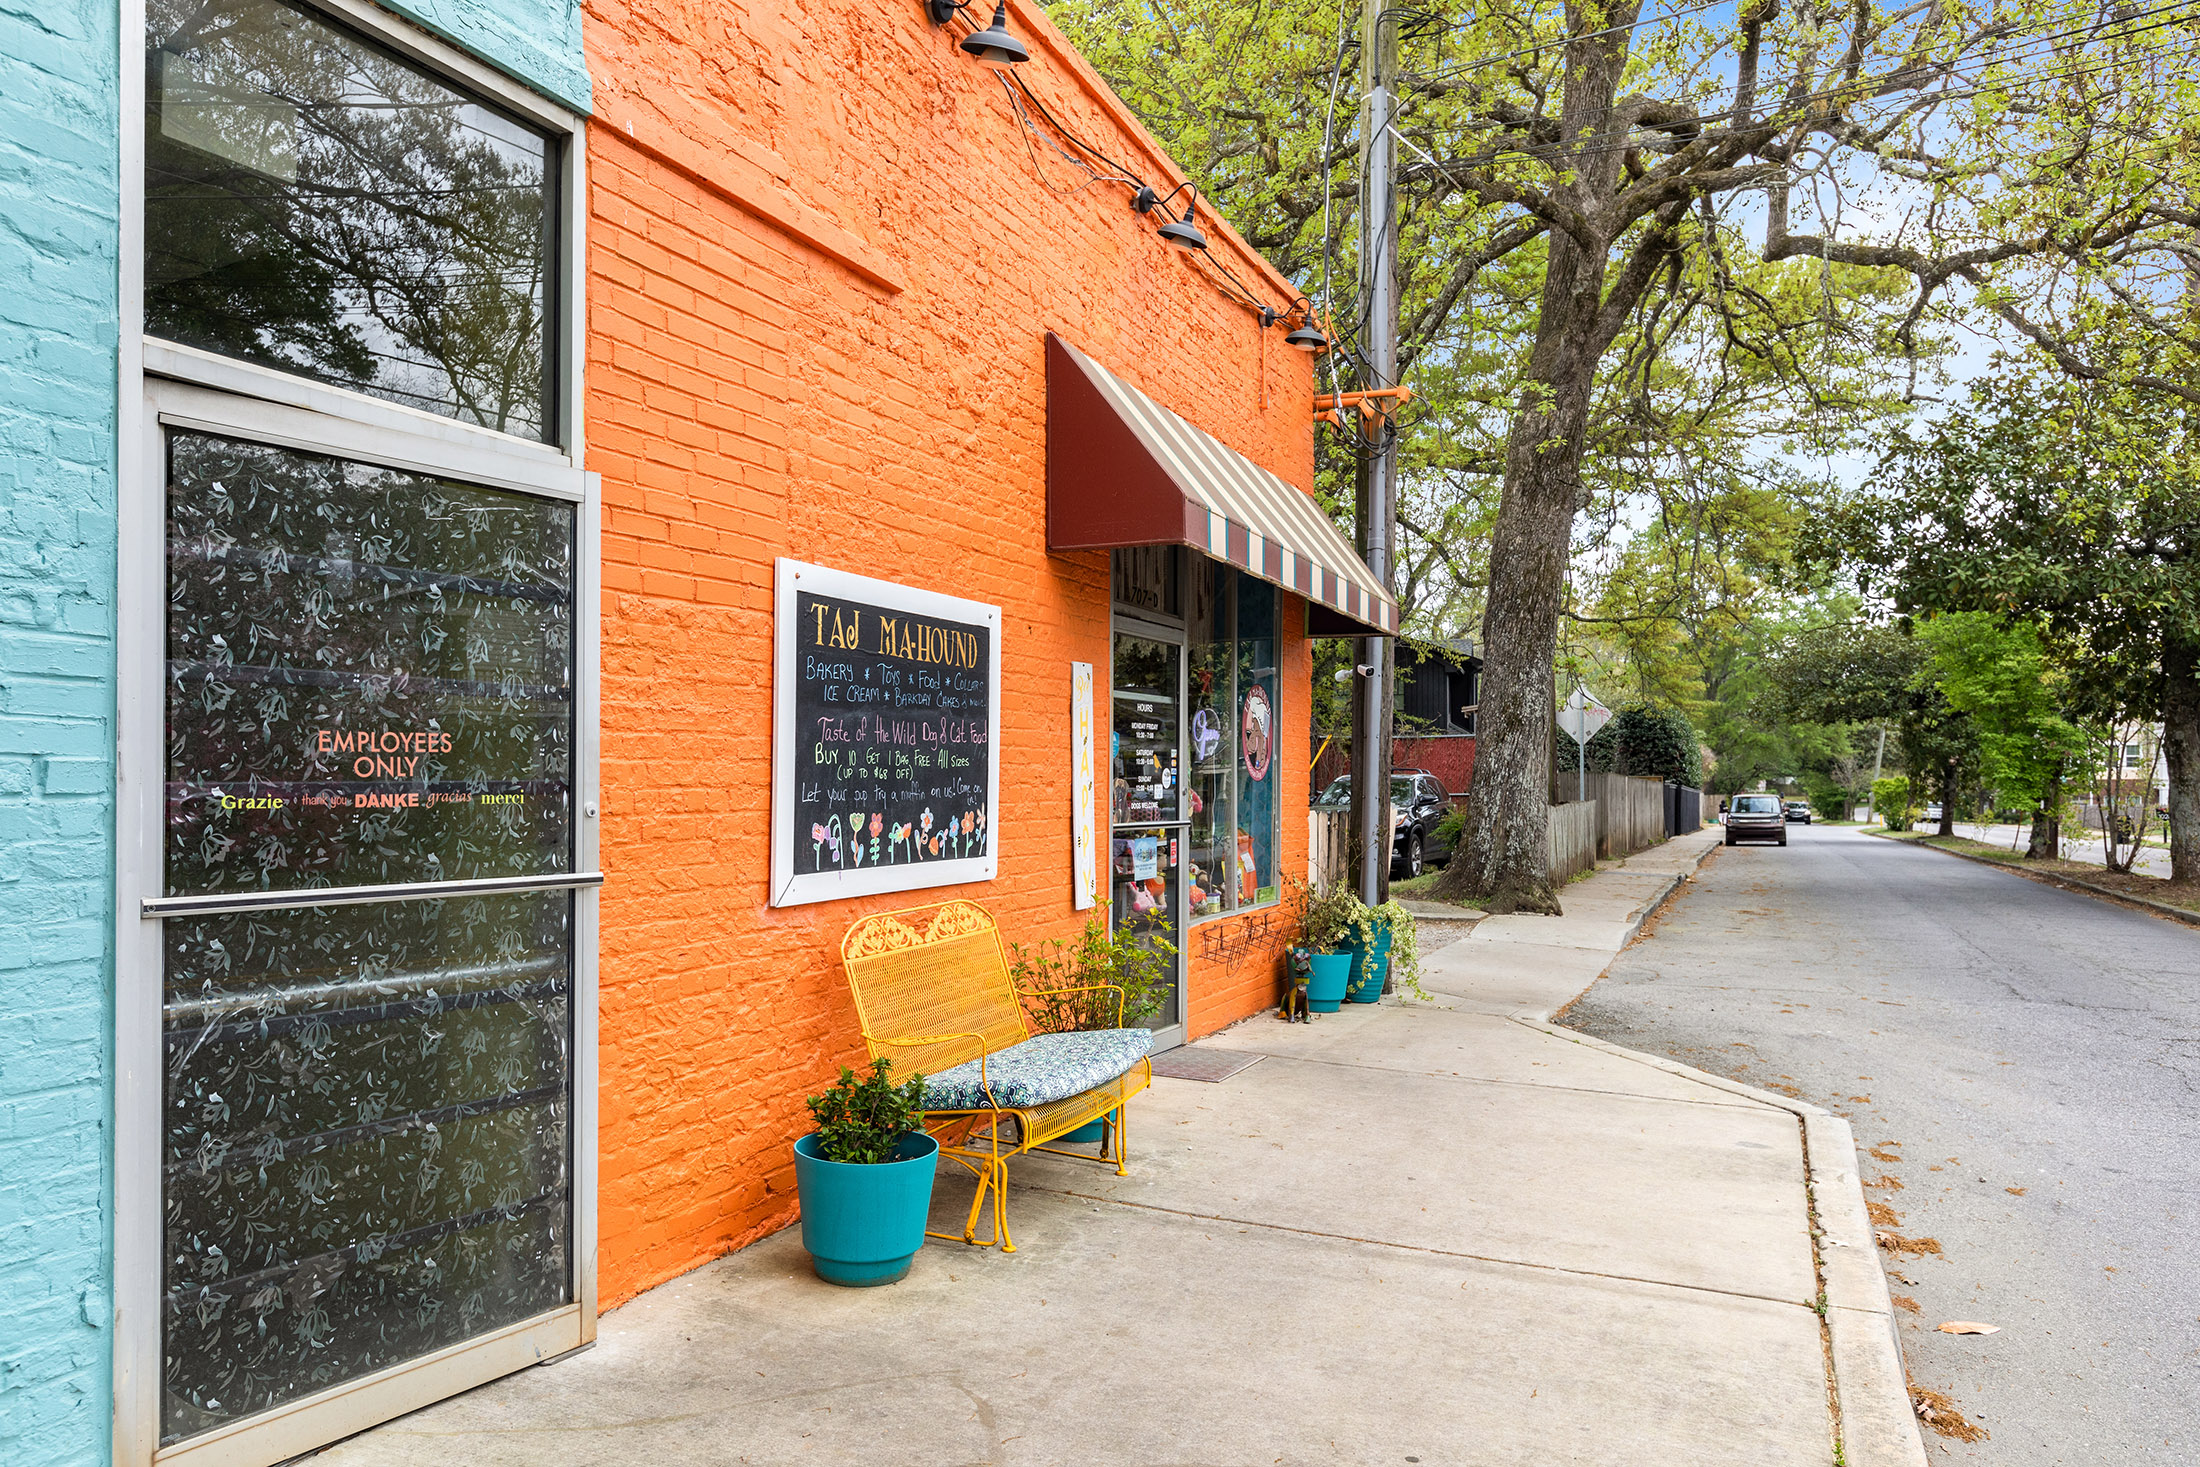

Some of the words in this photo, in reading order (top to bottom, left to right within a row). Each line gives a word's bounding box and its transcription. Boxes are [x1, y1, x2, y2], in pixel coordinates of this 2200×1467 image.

[1131, 585, 1159, 608] 707-D
[810, 602, 860, 650] TAJ
[878, 615, 978, 671] MA-HOUND
[805, 655, 854, 682] BAKERY
[824, 684, 839, 702] ICE
[846, 685, 880, 702] CREAM
[895, 687, 931, 708] BARKDAY
[1136, 703, 1153, 713] HOURS
[318, 730, 452, 754] EMPLOYEES
[817, 716, 850, 743] Taste
[856, 716, 867, 742] of
[874, 714, 890, 744] the
[892, 719, 917, 746] Wild
[922, 721, 938, 751] Dog
[950, 719, 965, 744] Cat
[969, 719, 987, 744] Food
[353, 756, 419, 778] ONLY
[815, 741, 839, 765] BUY
[848, 749, 857, 766] 10
[866, 747, 881, 766] GET
[914, 749, 931, 767] FREE
[937, 749, 949, 769] All
[837, 764, 853, 781] (UP
[859, 767, 868, 780] TO
[874, 766, 888, 780] $68
[895, 764, 914, 781] OFF)
[221, 793, 284, 809] Grazie
[301, 793, 329, 805] thank
[330, 796, 347, 808] you
[355, 793, 419, 808] DANKE
[425, 789, 472, 808] gracias
[481, 789, 525, 805] merci
[802, 782, 821, 803] Let
[827, 788, 847, 809] your
[854, 790, 868, 808] pup
[874, 784, 887, 809] try
[890, 791, 899, 802] a
[931, 787, 941, 798] on
[956, 776, 971, 794] Come
[1080, 706, 1091, 897] HAPPY
